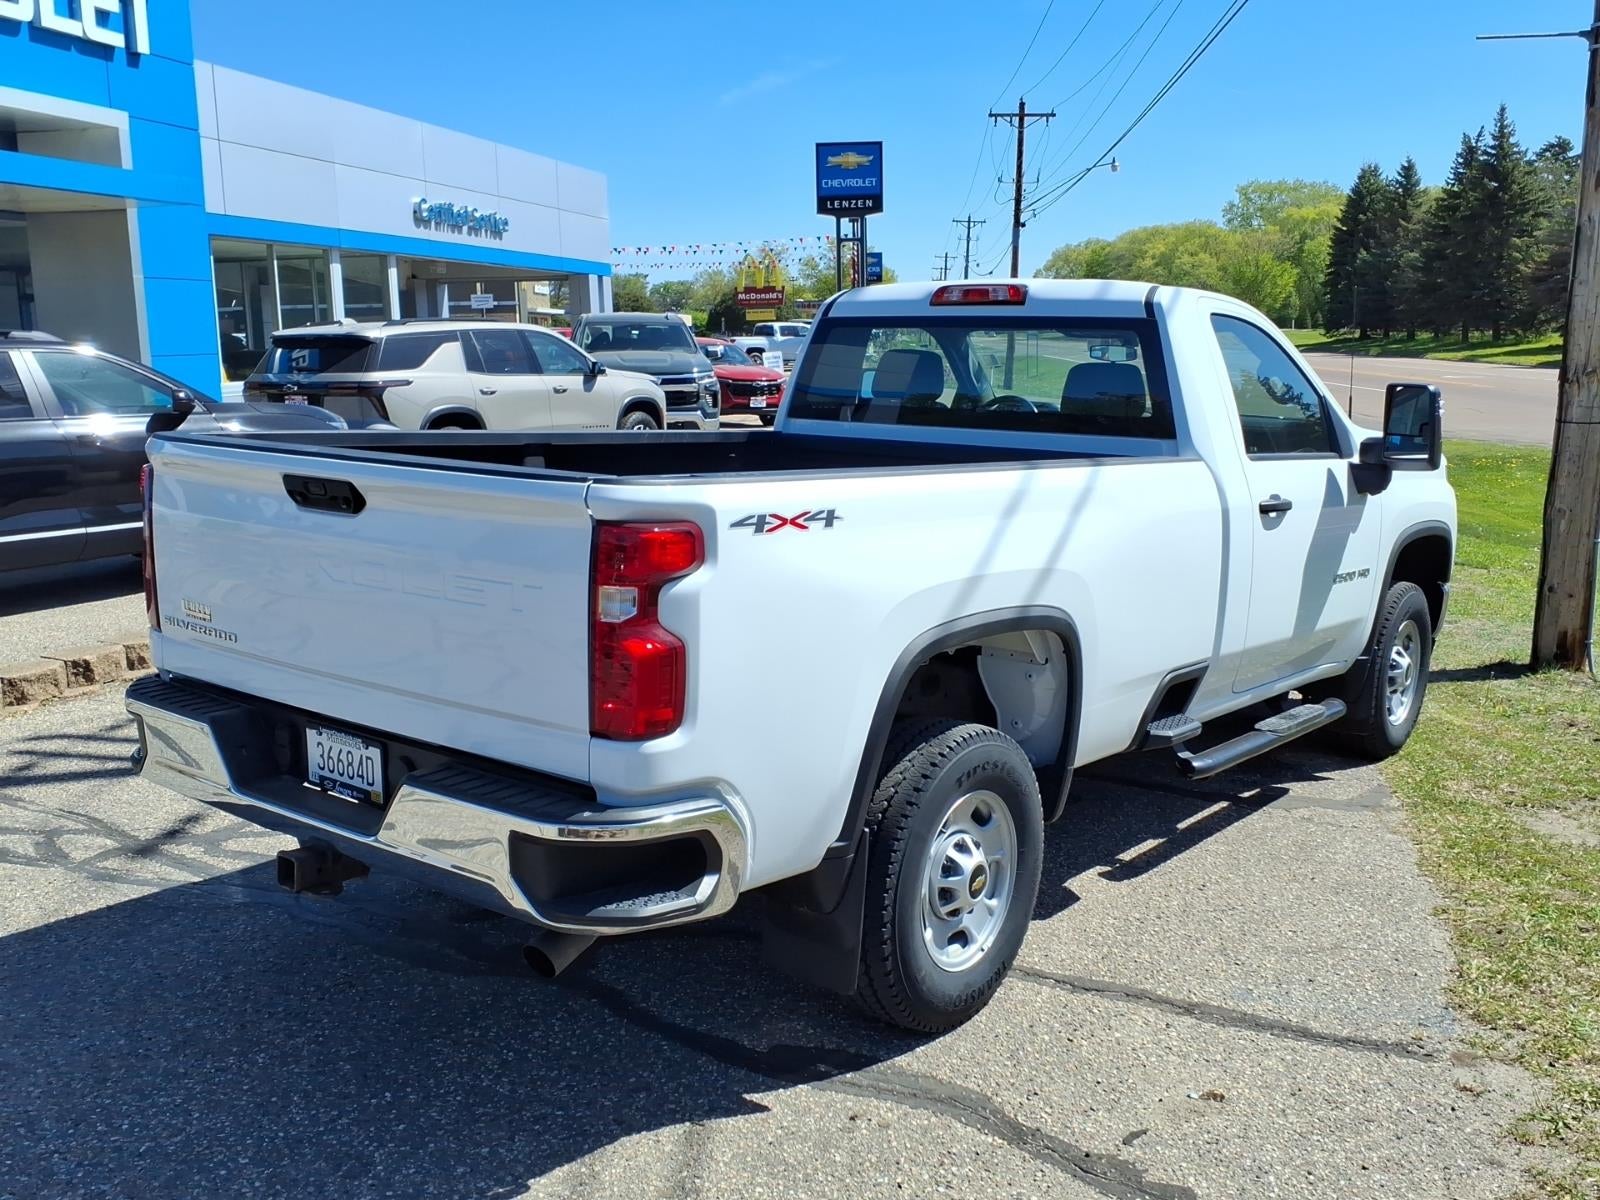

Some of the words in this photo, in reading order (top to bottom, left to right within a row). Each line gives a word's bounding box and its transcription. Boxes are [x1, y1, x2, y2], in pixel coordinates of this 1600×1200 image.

[822, 177, 877, 188] CHEVROLET
[827, 199, 873, 209] LENZEN
[413, 198, 468, 229] Certified
[469, 207, 508, 235] Service
[737, 292, 783, 300] McDonald's
[164, 614, 238, 644] SILVERADO
[316, 741, 375, 787] 36684D
